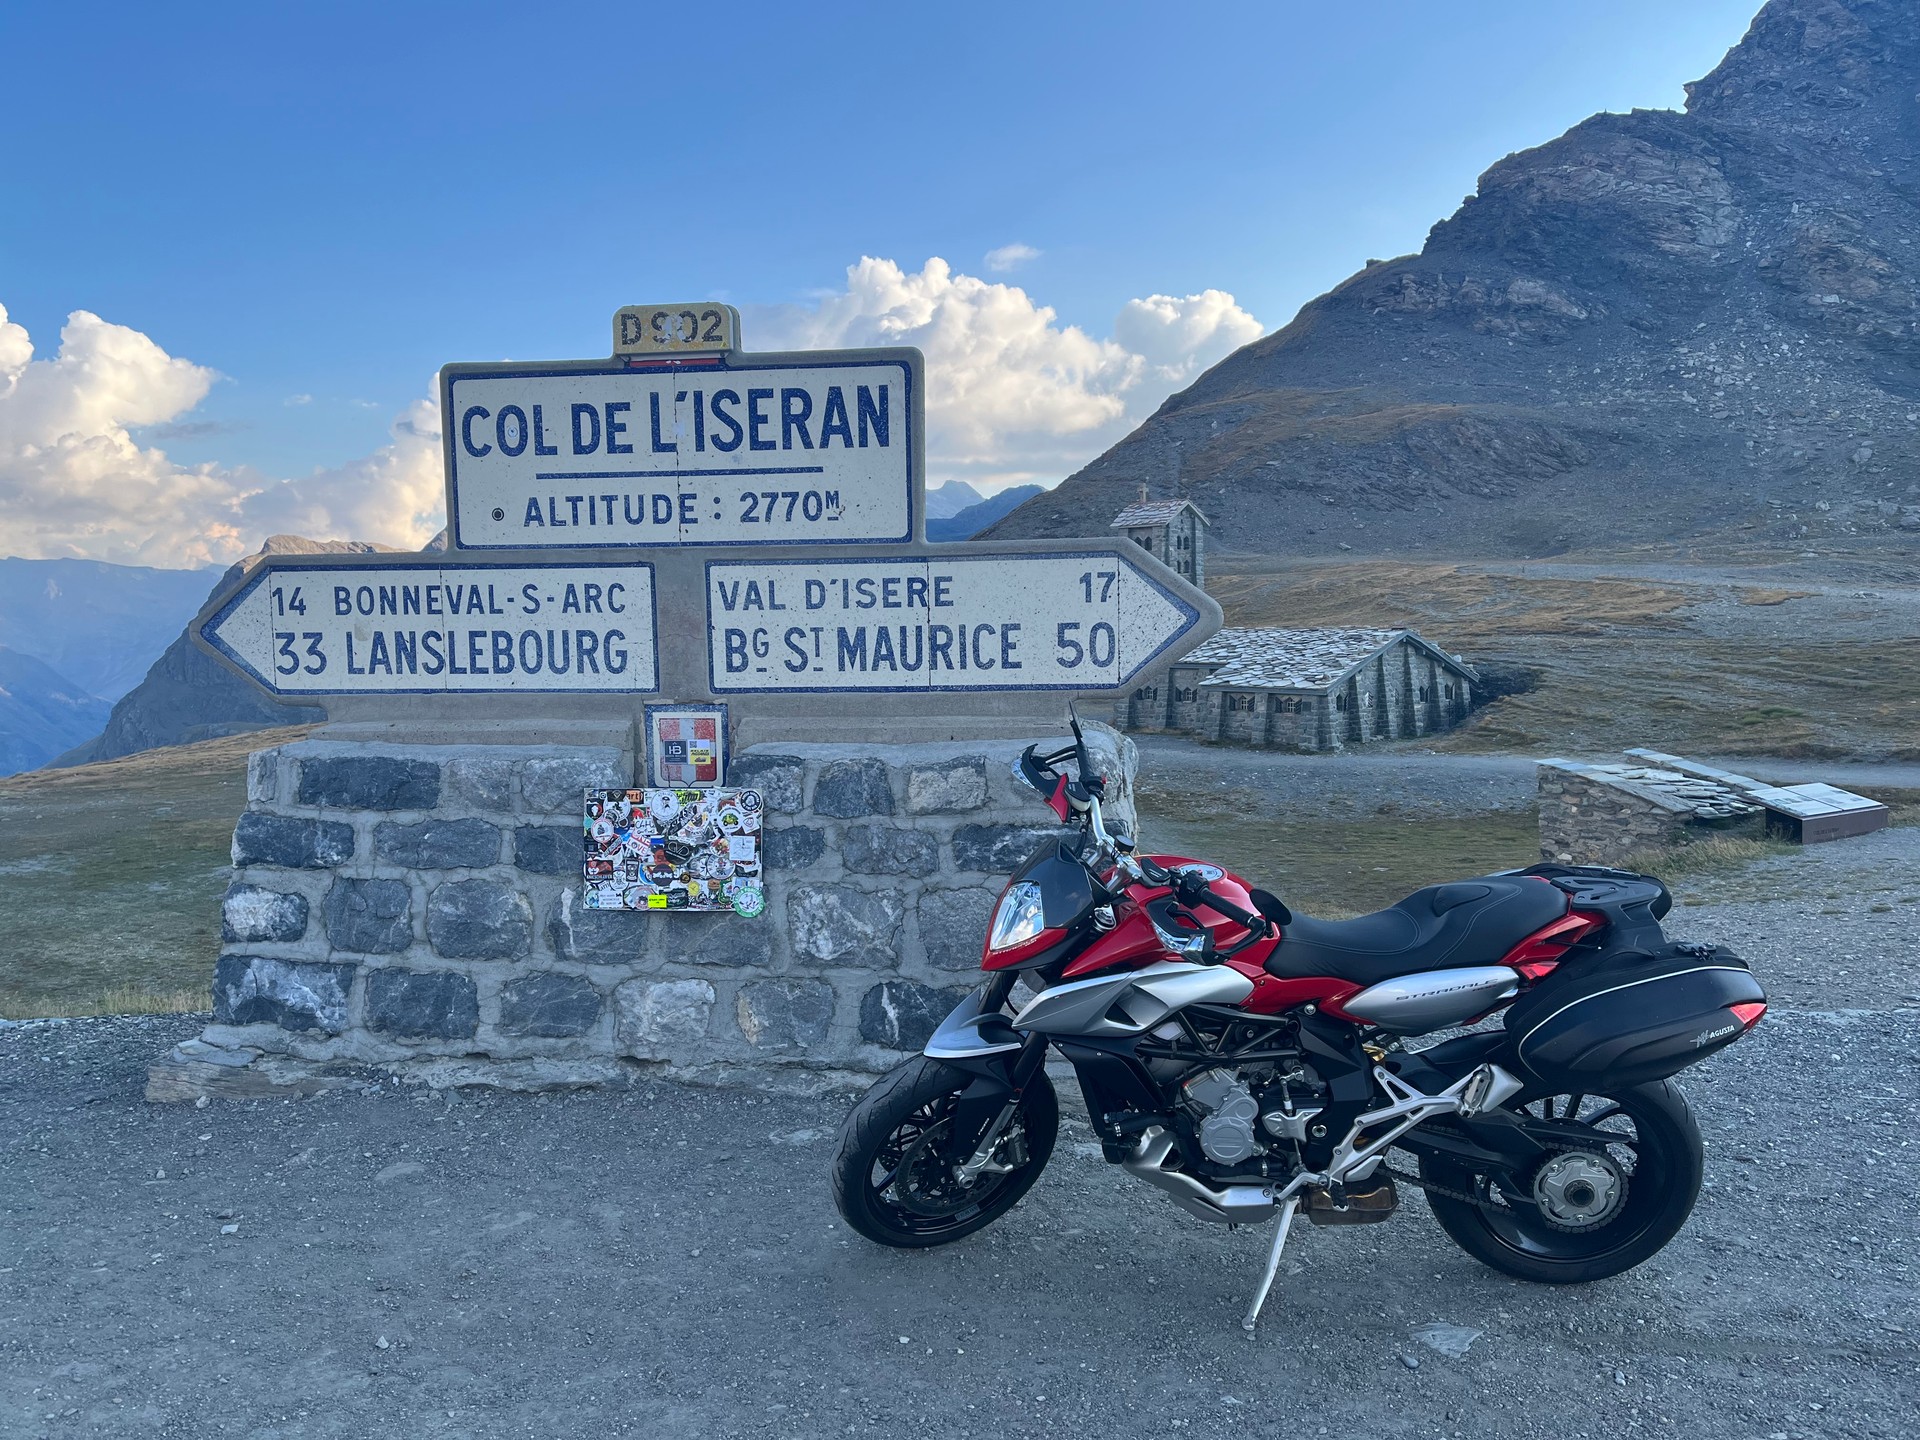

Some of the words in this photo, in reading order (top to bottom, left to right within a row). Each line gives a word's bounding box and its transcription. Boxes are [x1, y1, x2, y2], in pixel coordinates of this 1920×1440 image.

[621, 313, 641, 345] D
[651, 309, 722, 344] 902
[462, 402, 558, 457] COL
[571, 401, 634, 455] DE
[650, 384, 890, 453] L'ISERAN
[524, 493, 698, 528] ALTITUDE
[272, 586, 306, 617] 14
[334, 583, 627, 617] BONNEVAL-S-ARC
[717, 579, 786, 611] VAL
[805, 575, 954, 610] D'ISERE
[1079, 571, 1116, 604] 17
[274, 631, 328, 676] 33
[346, 629, 628, 676] LANSLEBOURG
[837, 622, 1022, 672] MAURICE
[1056, 621, 1116, 669] 50
[1395, 978, 1499, 1001] STRADALE
[1709, 1025, 1735, 1039] AGUSTA
